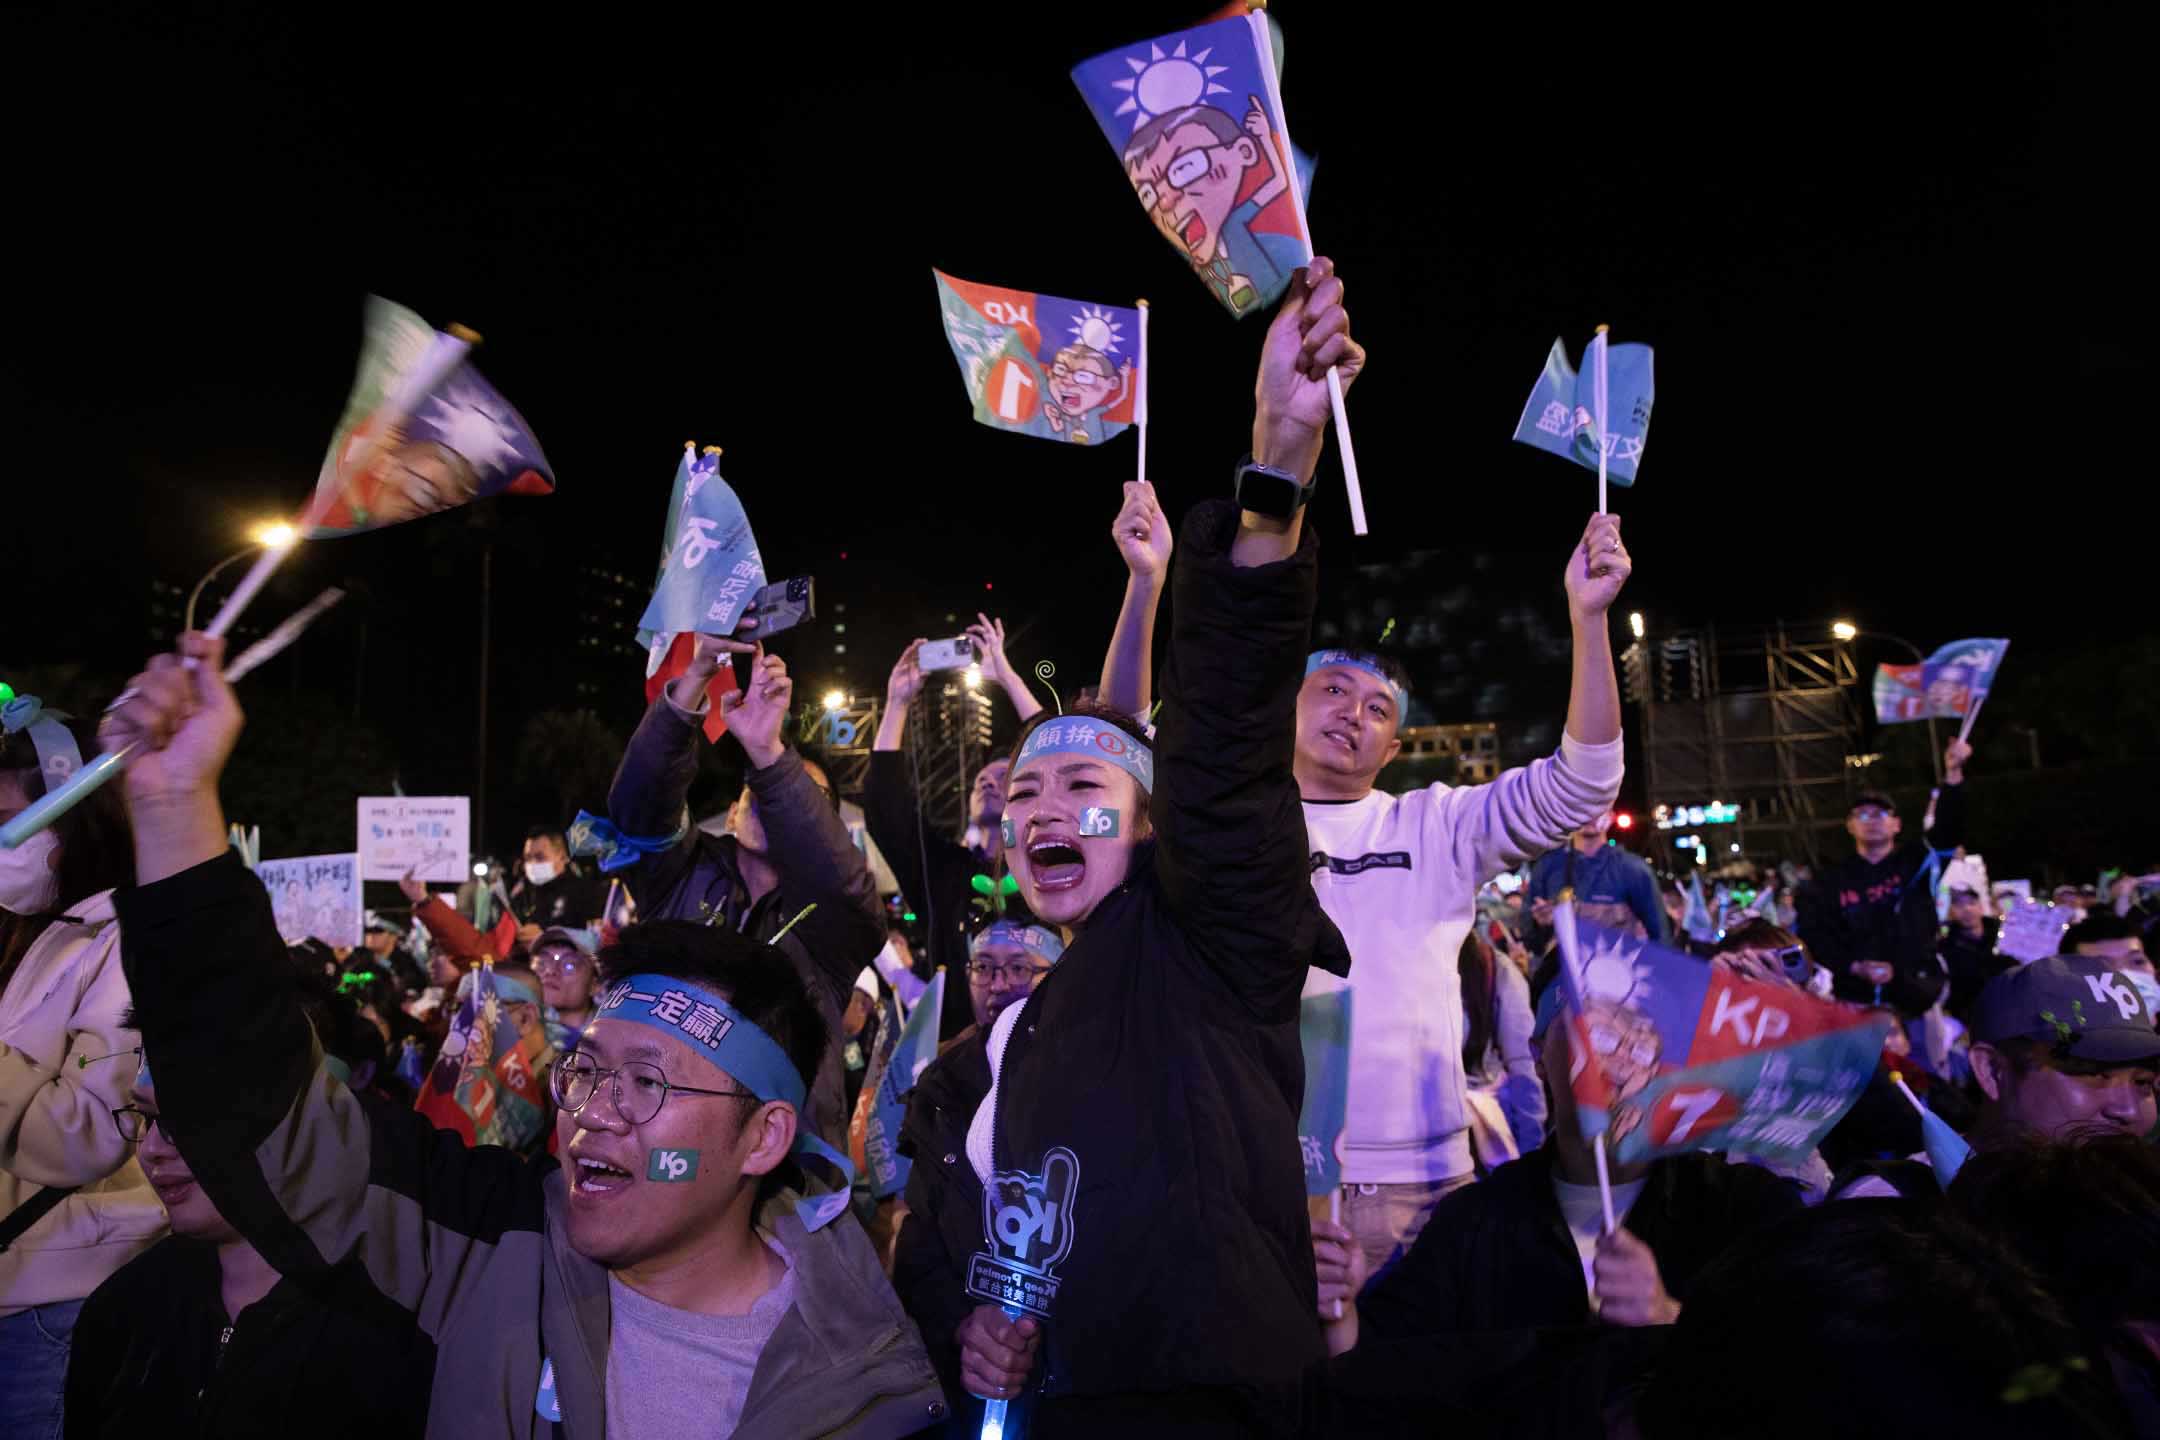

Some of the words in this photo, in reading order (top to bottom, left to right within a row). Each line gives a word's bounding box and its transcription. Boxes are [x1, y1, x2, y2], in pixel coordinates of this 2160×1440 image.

[1085, 807, 1113, 834] Kp
[2084, 972, 2140, 1020] Kp
[659, 1151, 689, 1179] Kp
